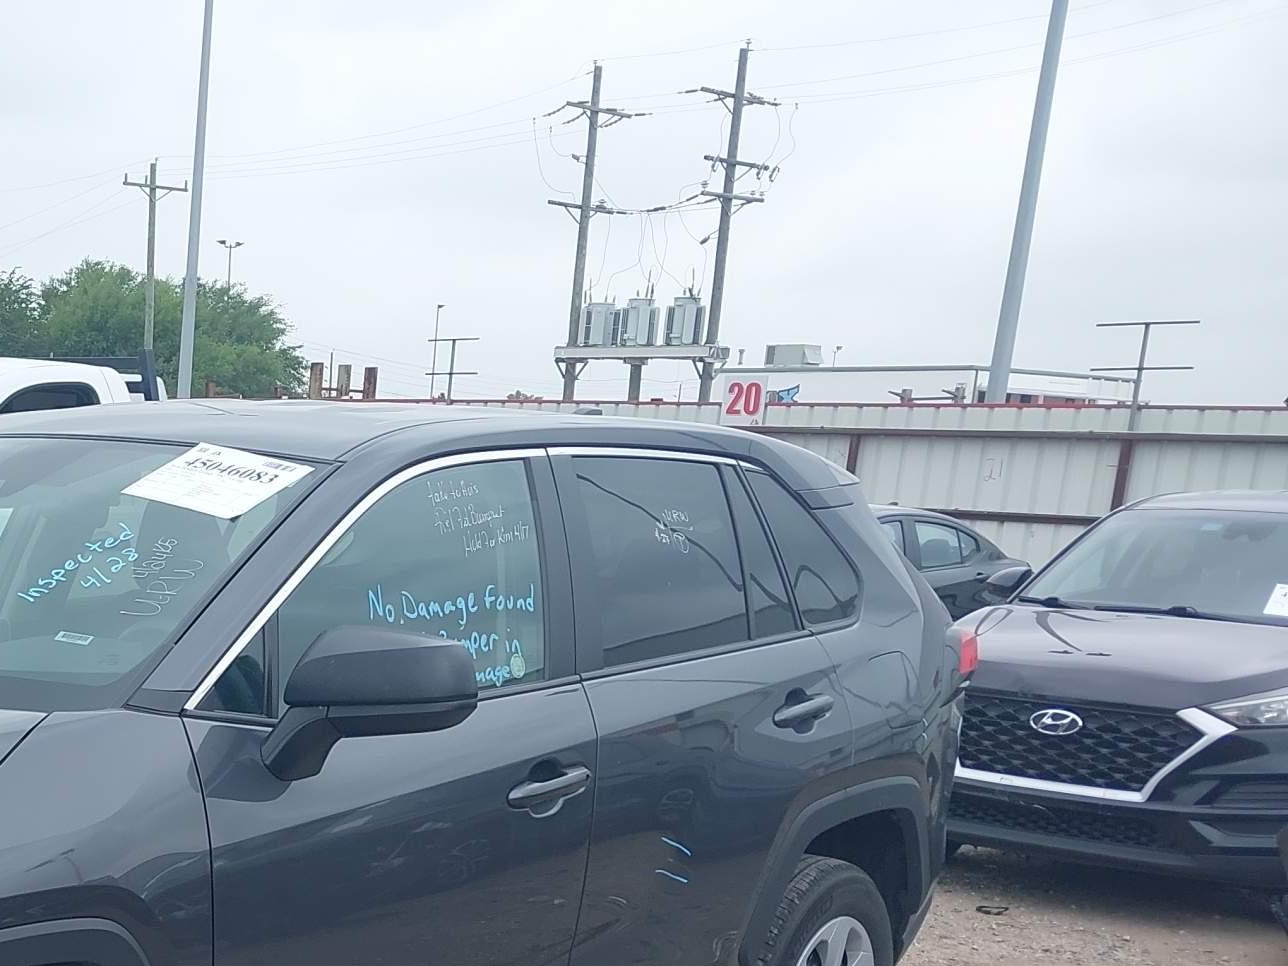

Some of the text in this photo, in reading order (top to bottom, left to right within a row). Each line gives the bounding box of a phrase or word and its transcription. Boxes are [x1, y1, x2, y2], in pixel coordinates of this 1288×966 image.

[726, 382, 762, 416] 20
[184, 456, 280, 485] 45046083
[80, 547, 138, 588] 4/28
[368, 584, 395, 623] No
[401, 590, 479, 626] Damage
